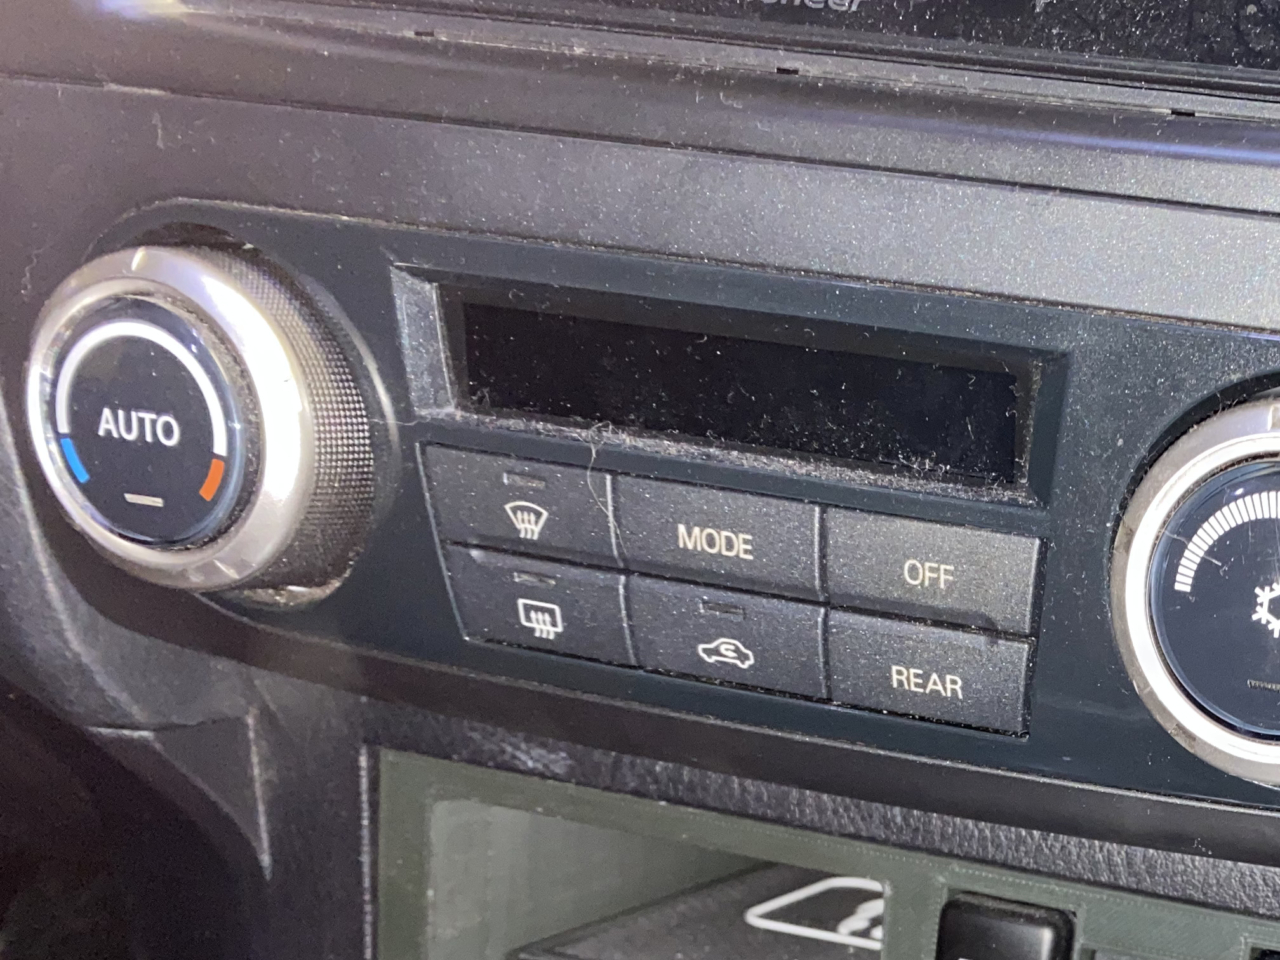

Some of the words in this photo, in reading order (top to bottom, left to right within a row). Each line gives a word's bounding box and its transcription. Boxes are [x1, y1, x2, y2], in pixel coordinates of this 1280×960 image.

[98, 407, 180, 447] AUTO
[677, 524, 754, 560] MODE
[903, 559, 955, 589] OFF
[891, 665, 964, 699] REAR
